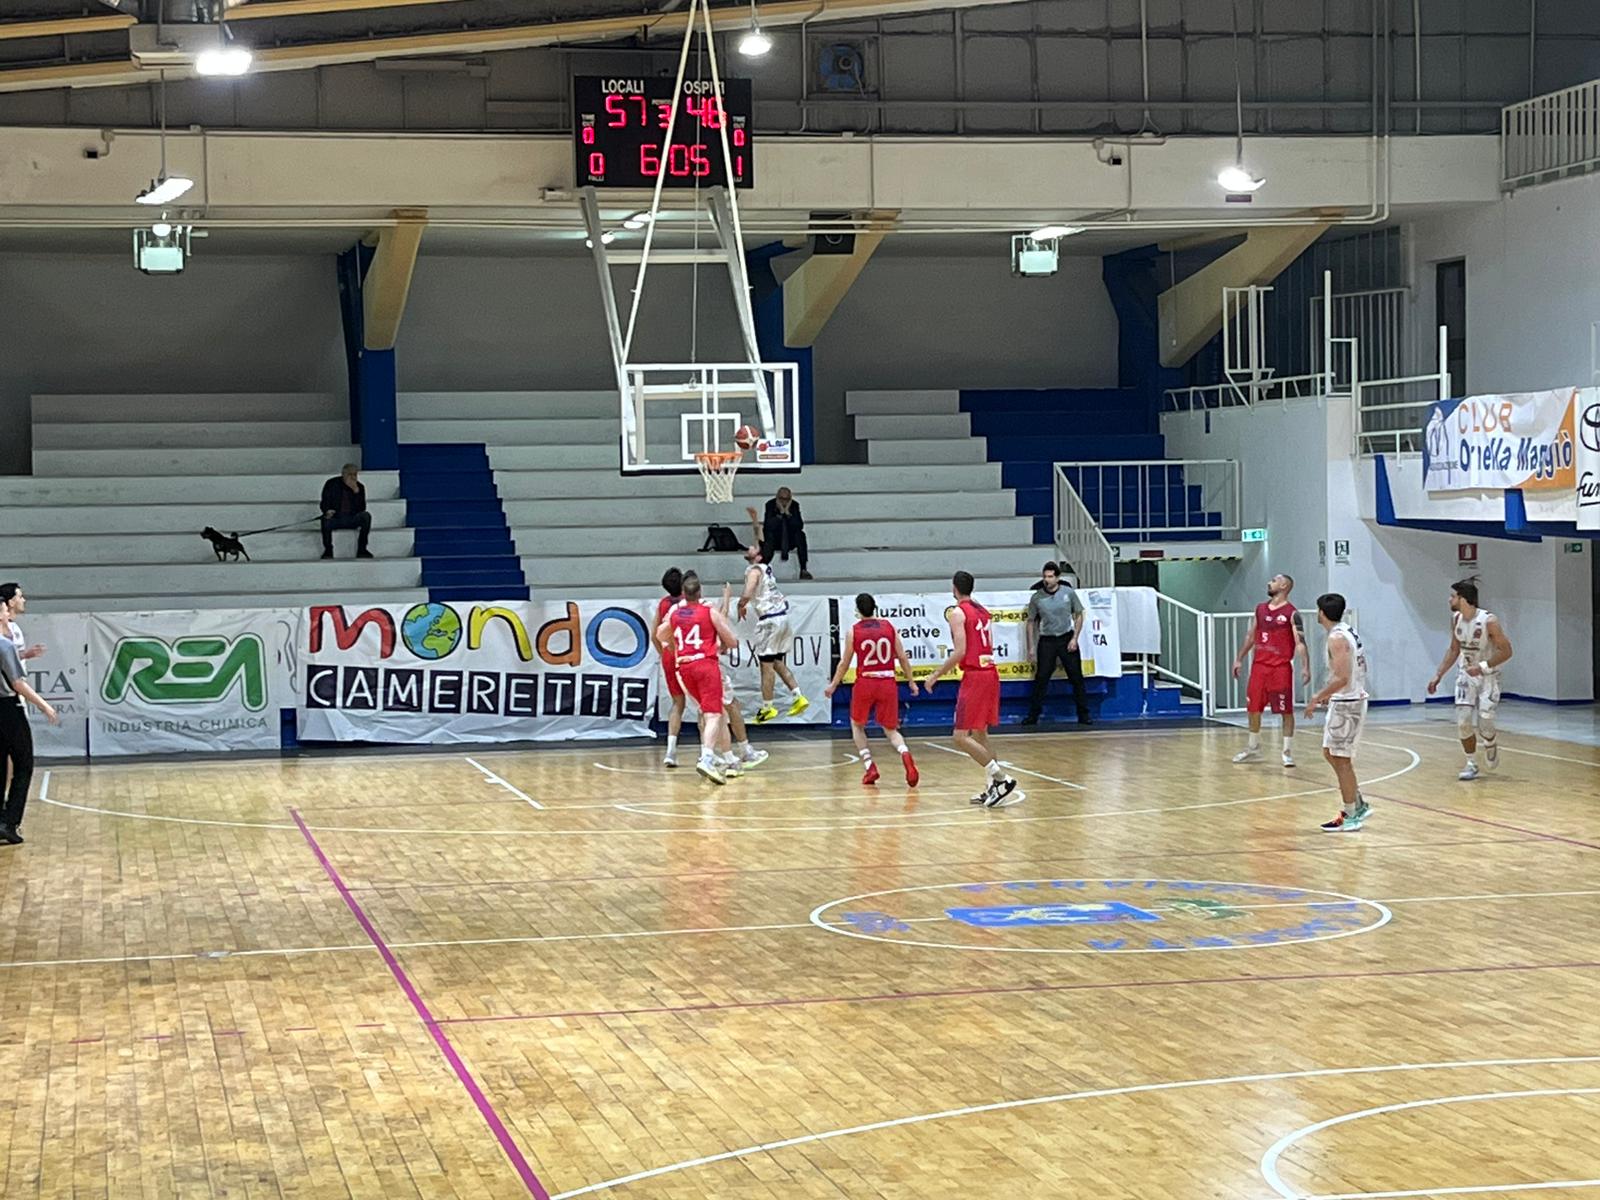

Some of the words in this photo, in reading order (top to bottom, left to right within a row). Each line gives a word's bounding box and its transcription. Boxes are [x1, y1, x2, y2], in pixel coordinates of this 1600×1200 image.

[602, 79, 645, 94] LOCALI
[605, 95, 647, 128] 57
[582, 127, 595, 144] 0
[733, 129, 745, 146] 0
[589, 152, 605, 175] 0
[736, 155, 743, 176] 1
[1458, 402, 1513, 434] CLUB
[856, 604, 926, 618] luzioni
[673, 624, 704, 650] 14
[1261, 632, 1269, 643] 5
[860, 637, 892, 666] 20
[101, 633, 268, 711] REA
[309, 669, 646, 717] CAMERETTE
[102, 720, 192, 733] INDUSTRIA
[199, 718, 268, 731] CHIMICA
